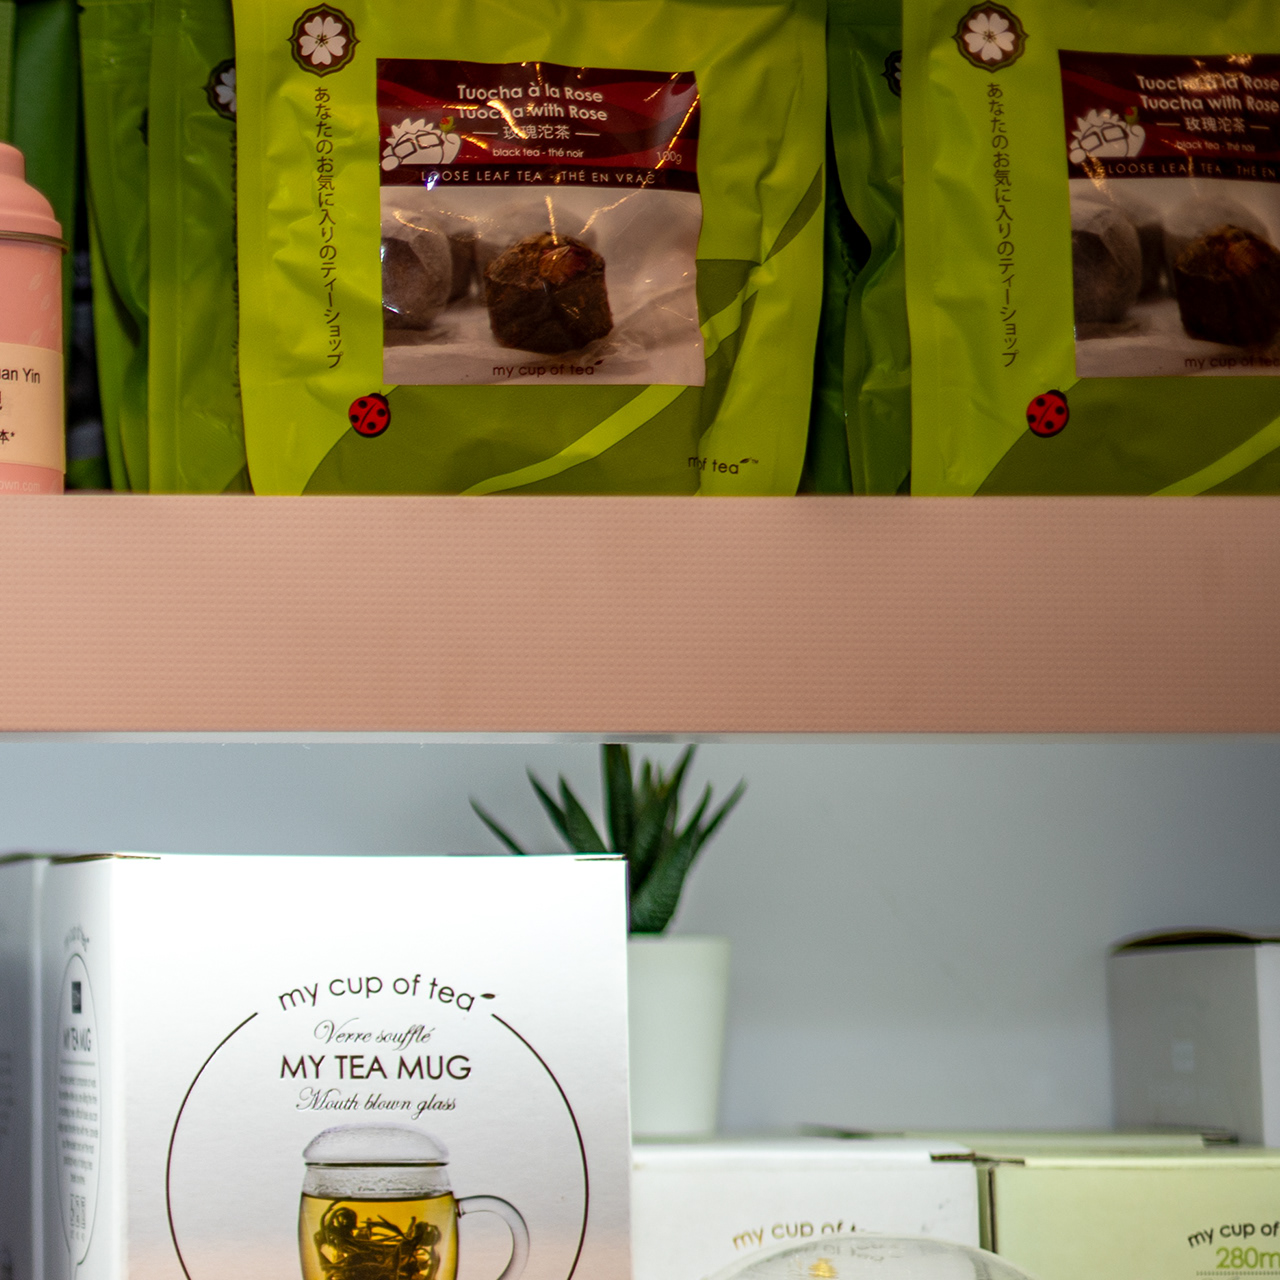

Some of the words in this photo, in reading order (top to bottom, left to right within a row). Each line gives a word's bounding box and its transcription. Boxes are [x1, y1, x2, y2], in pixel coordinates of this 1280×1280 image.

[1242, 74, 1280, 91] Rose
[457, 84, 522, 100] Tuocha
[528, 82, 540, 98] à
[545, 83, 560, 99] la
[566, 87, 603, 102] Rose
[529, 104, 564, 118] with
[569, 106, 608, 121] Rose
[1140, 95, 1204, 110] Tuocha
[1208, 96, 1242, 110] with
[1246, 96, 1280, 112] Rose
[492, 148, 521, 158] black
[523, 148, 540, 158] tea
[548, 147, 564, 158] thé
[567, 149, 584, 159] noir
[477, 171, 510, 181] LEAF
[517, 171, 542, 181] TEA
[562, 169, 585, 181] THÉ
[592, 172, 610, 183] EN
[1109, 163, 1155, 174] LOOSE
[1201, 163, 1222, 174] TEA
[315, 86, 344, 369] あなたのお気に入りのティーショップ
[987, 83, 1019, 367] あなたのお気に入りのティーショップ
[22, 368, 40, 384] Yin
[493, 365, 513, 378] my
[519, 365, 546, 377] cup
[550, 363, 563, 375] of
[570, 363, 594, 375] tea
[712, 459, 739, 475] tea
[278, 982, 318, 1011] my
[329, 975, 383, 999] cup
[392, 974, 421, 997] of
[429, 977, 475, 1012] tea
[313, 1017, 372, 1044] Verre
[375, 1024, 436, 1052] soufflé
[279, 1054, 326, 1080] MY
[334, 1054, 389, 1080] TEA
[397, 1054, 472, 1080] MUG
[295, 1086, 360, 1112] Mouth
[363, 1093, 413, 1112] blown
[412, 1094, 457, 1121] glass
[732, 1226, 764, 1251] my
[1187, 1227, 1214, 1248] my
[1219, 1222, 1256, 1239] cup
[1260, 1220, 1280, 1237] of
